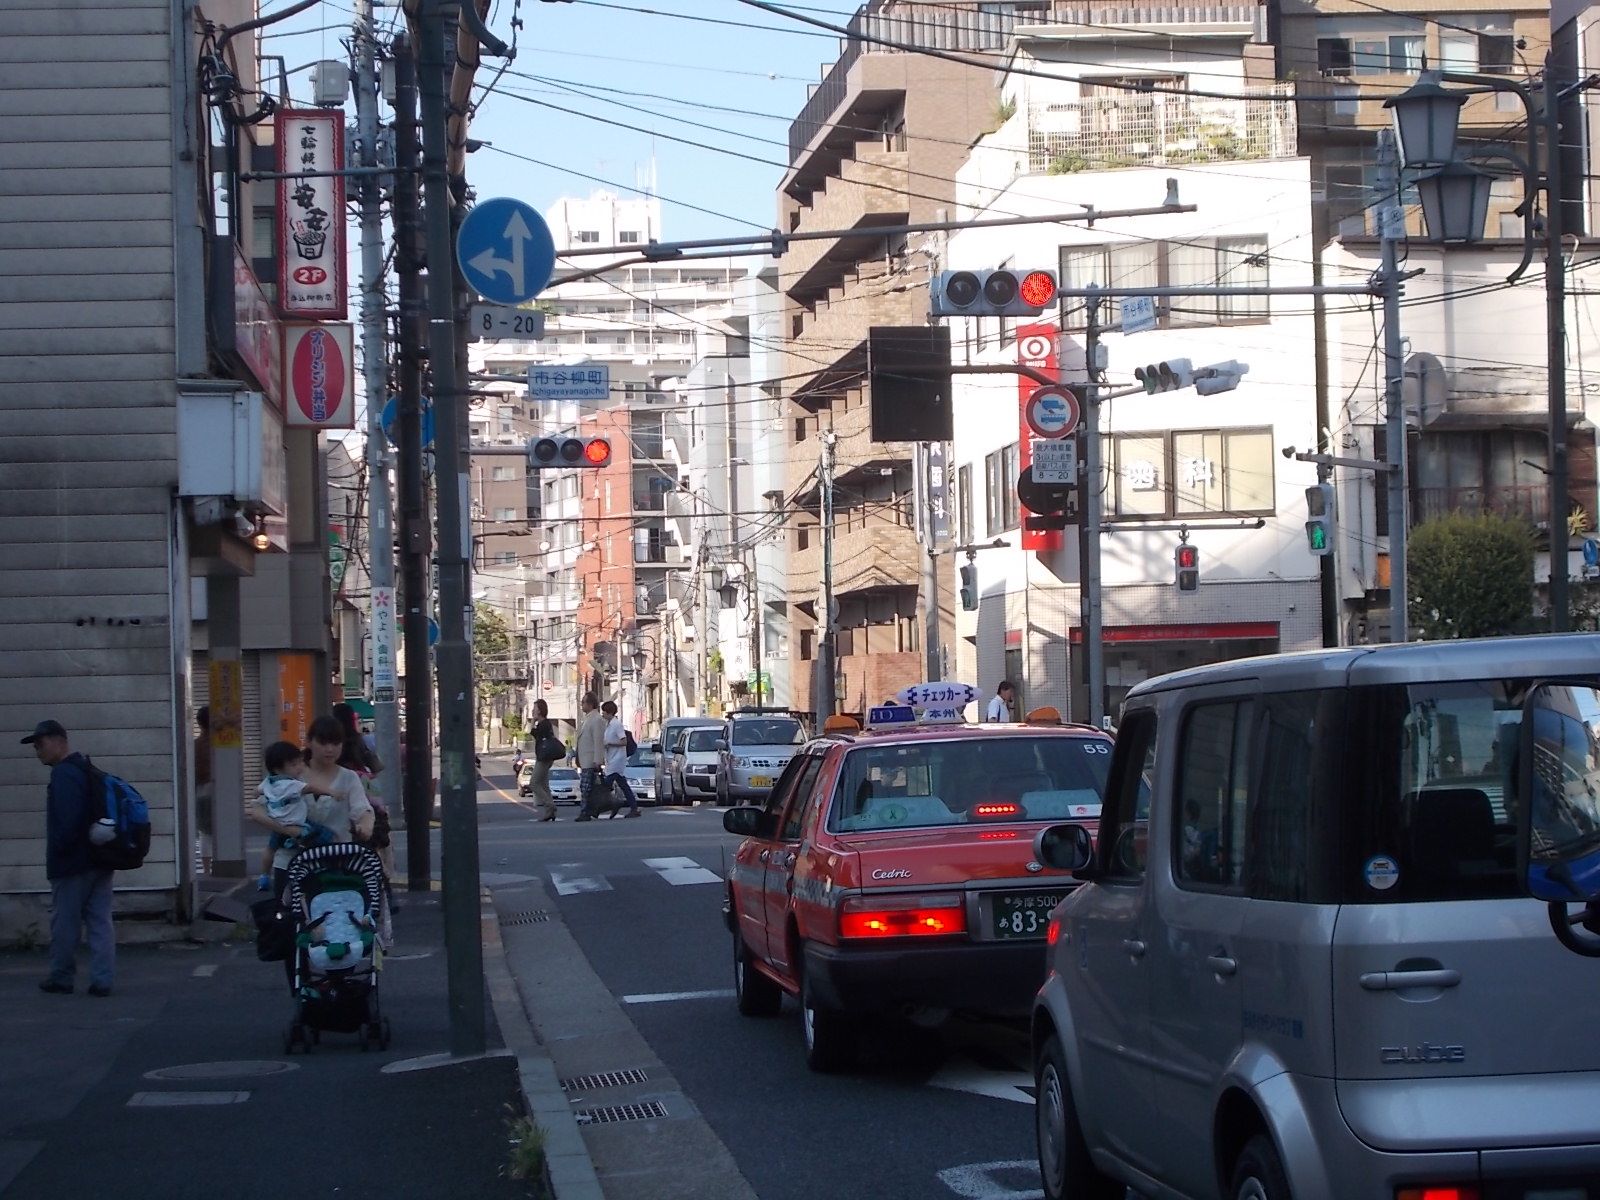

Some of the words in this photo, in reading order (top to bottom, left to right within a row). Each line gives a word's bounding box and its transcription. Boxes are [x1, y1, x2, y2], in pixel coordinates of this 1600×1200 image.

[298, 269, 323, 282] 2F
[311, 331, 326, 420] オリジン弁当
[534, 370, 602, 385] 市谷柳町
[922, 686, 961, 703] チェッカー
[928, 708, 956, 719] 本州
[1083, 744, 1108, 754] 55
[871, 868, 912, 880] Cedric
[1037, 896, 1058, 908] 500
[999, 917, 1009, 929] あ
